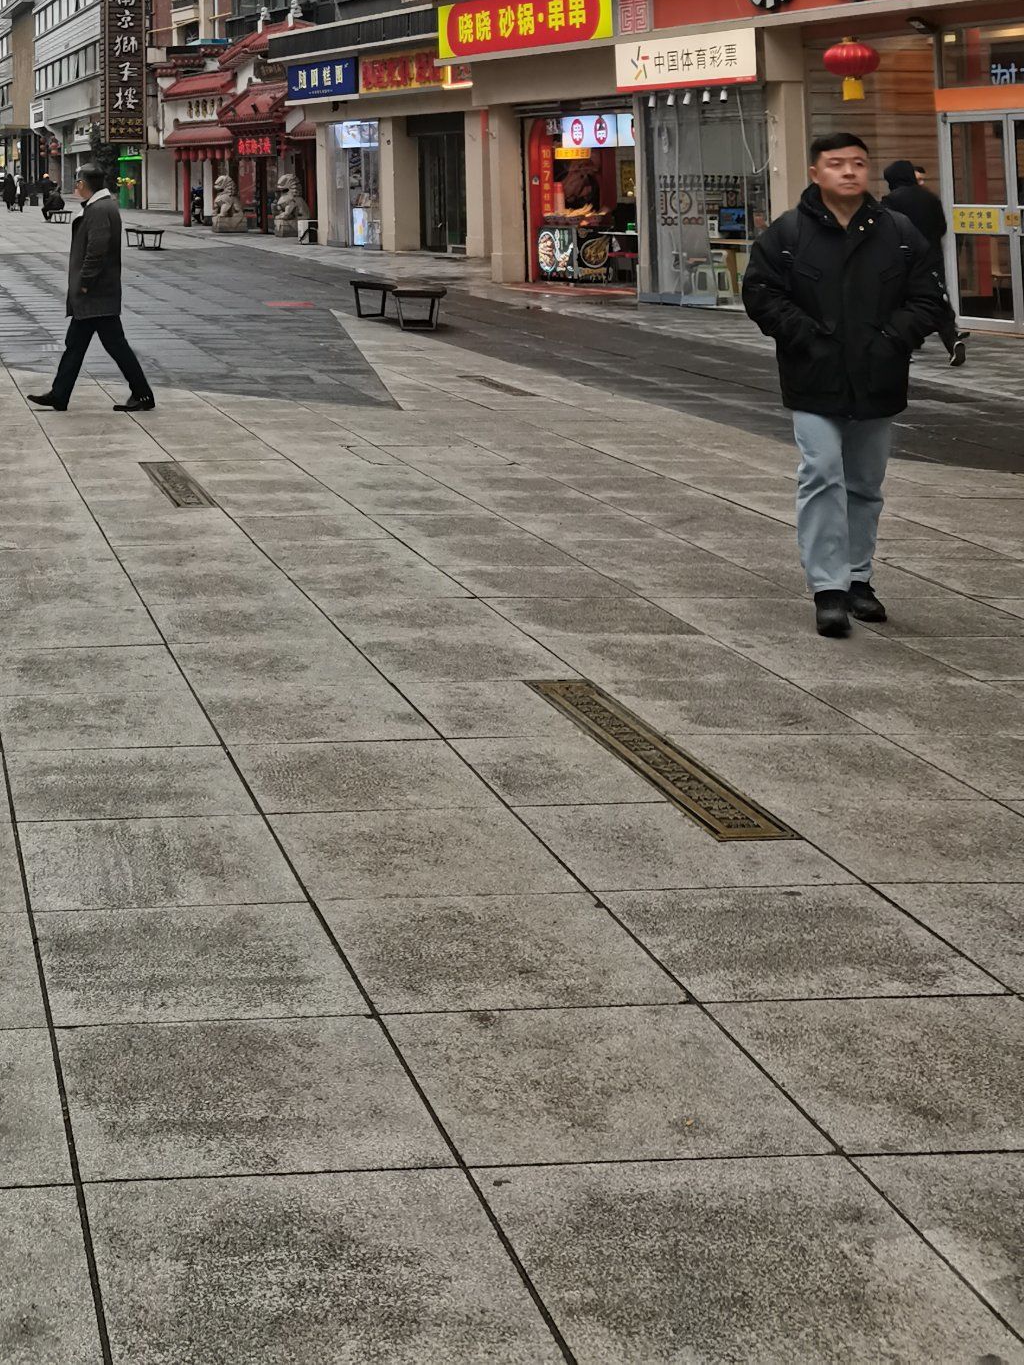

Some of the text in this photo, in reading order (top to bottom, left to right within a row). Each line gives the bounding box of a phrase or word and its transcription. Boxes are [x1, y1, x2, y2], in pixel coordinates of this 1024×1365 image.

[458, 12, 492, 44] 晓晓
[654, 44, 738, 74] 中国体育彩票
